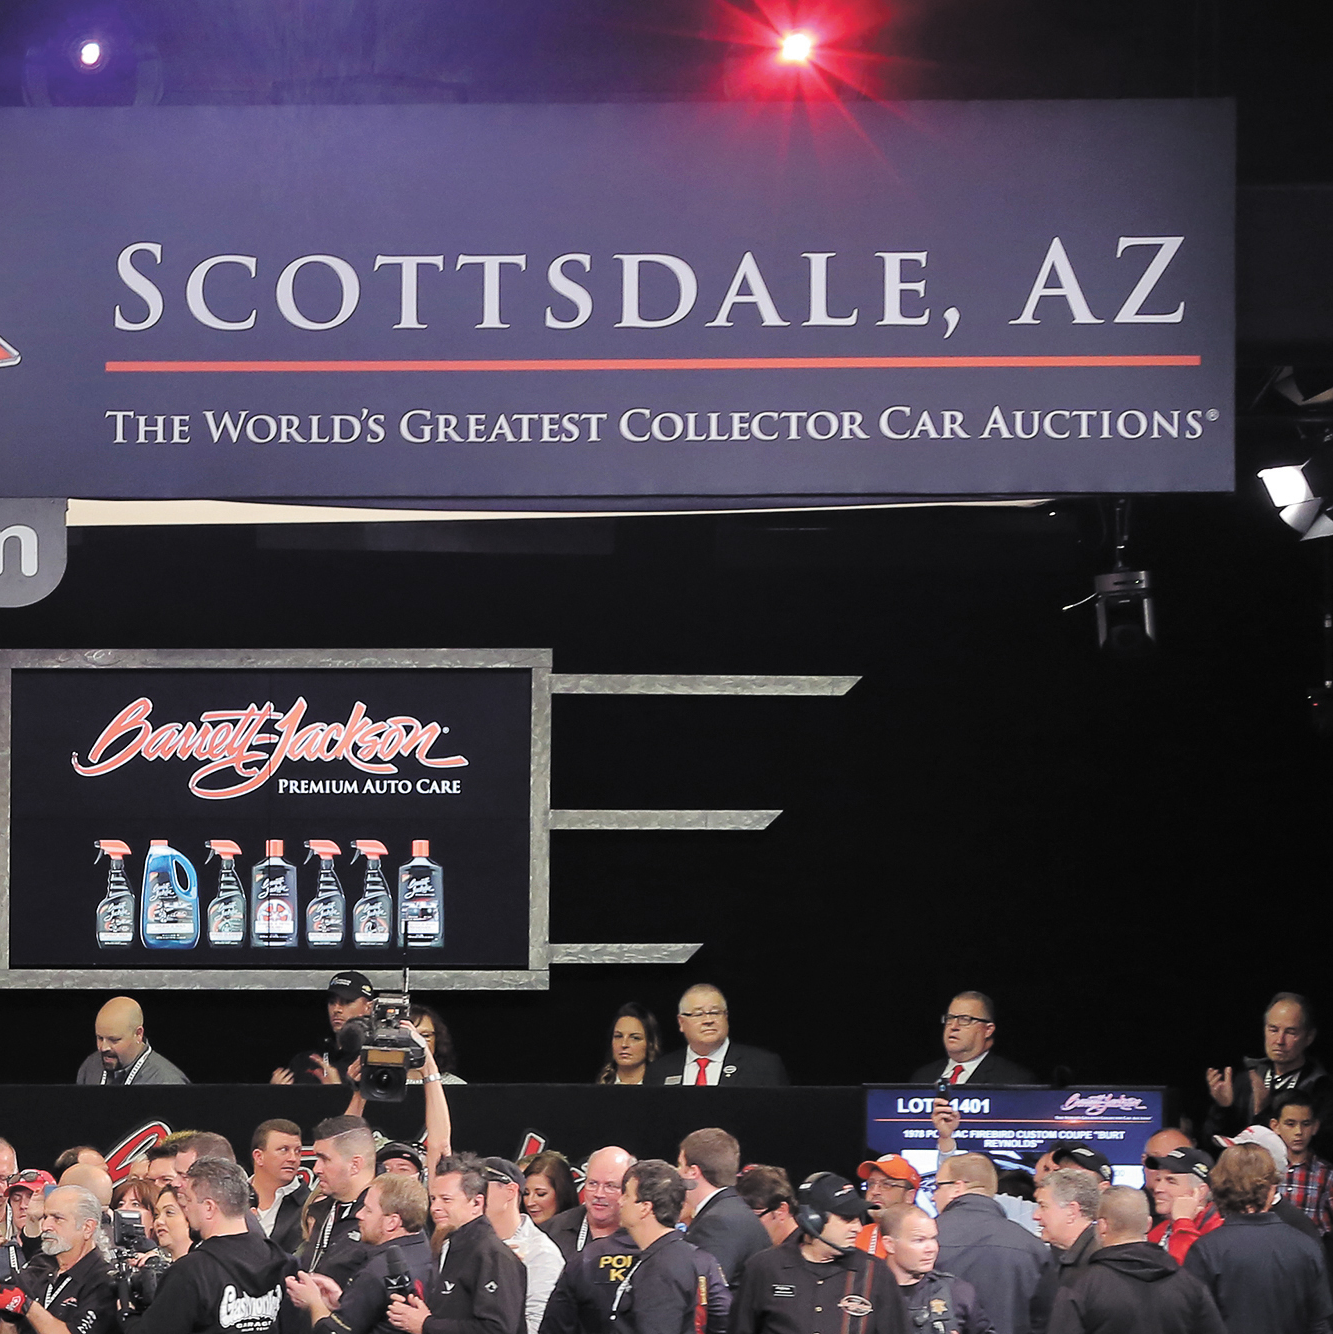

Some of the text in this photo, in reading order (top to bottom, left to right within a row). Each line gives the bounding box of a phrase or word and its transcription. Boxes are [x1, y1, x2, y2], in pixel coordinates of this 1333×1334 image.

[112, 234, 1189, 340] SCOTTSDALE, AZ
[105, 409, 191, 444] THE
[202, 408, 385, 445] WORLD'S
[399, 409, 609, 444] GREATEST
[619, 407, 871, 443] COLLECTOR
[879, 406, 967, 441] CAR
[71, 696, 469, 801] Barrett-Jackson
[277, 778, 462, 796] PREMIUM AUTO CARE
[897, 1098, 991, 1114] LOT 1401
[1058, 1130, 1093, 1140] COUPE
